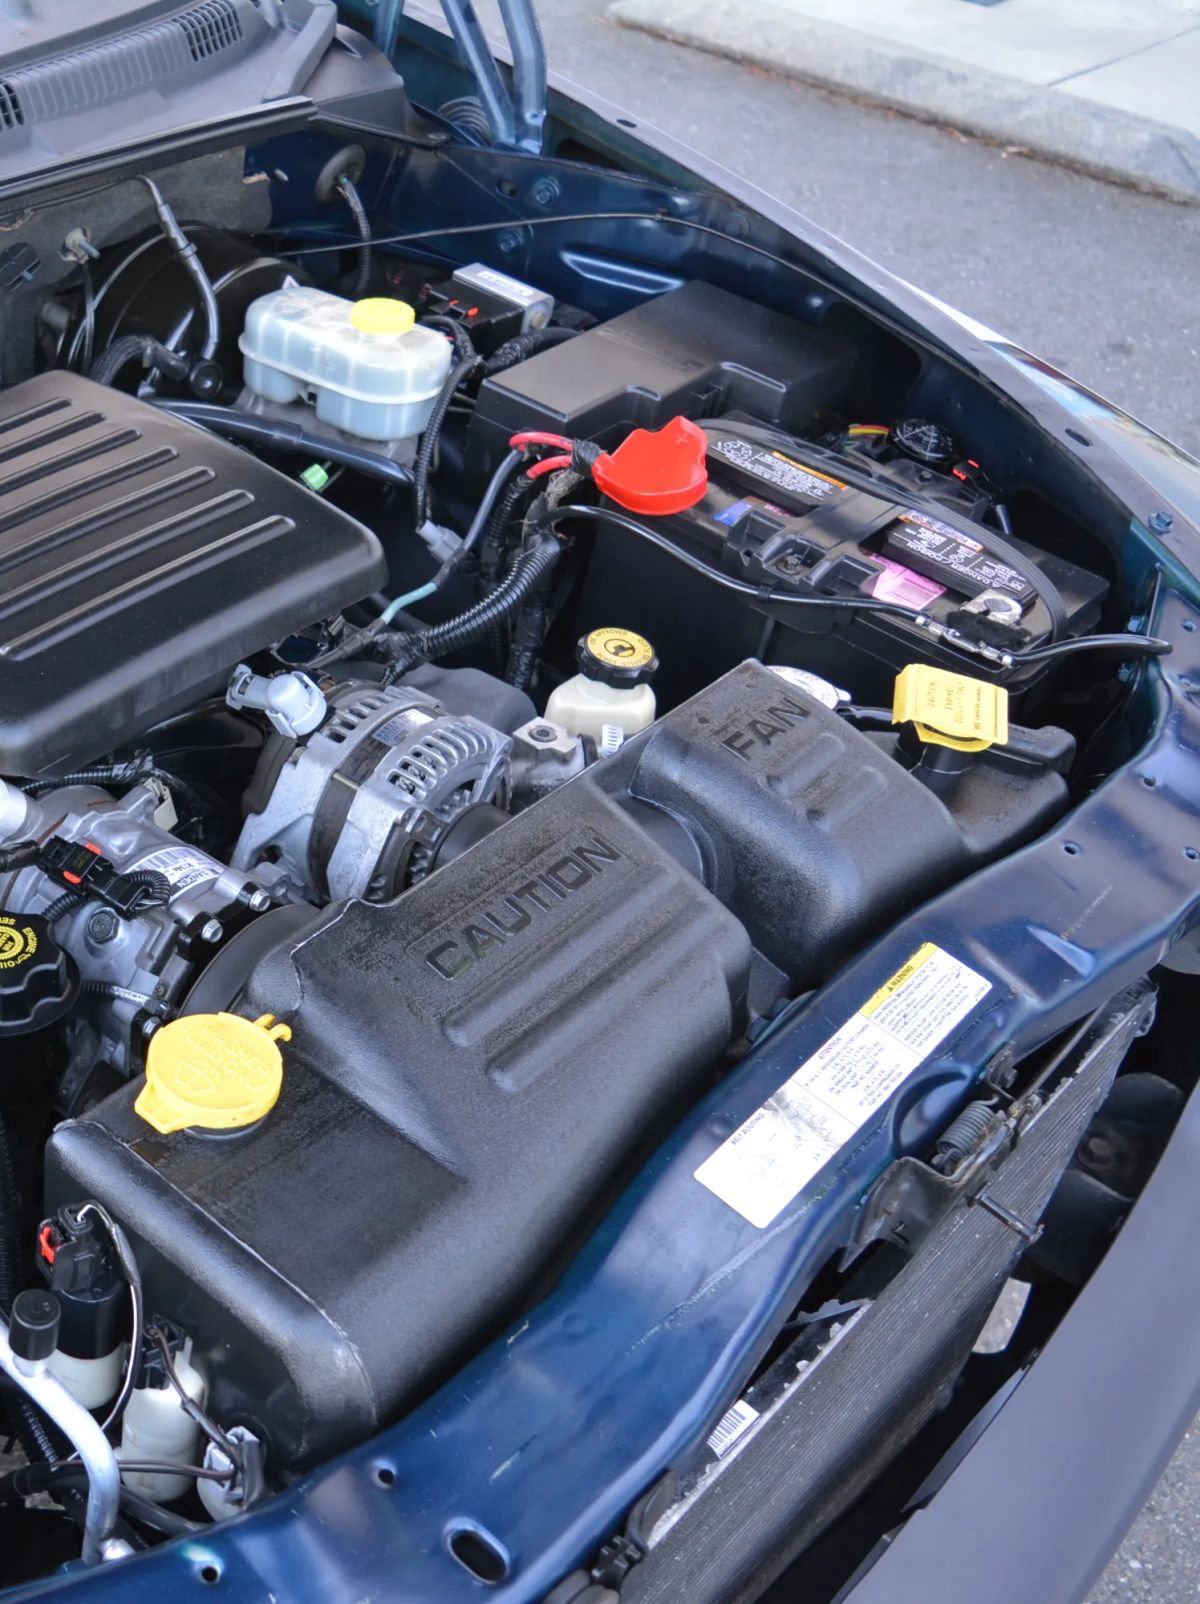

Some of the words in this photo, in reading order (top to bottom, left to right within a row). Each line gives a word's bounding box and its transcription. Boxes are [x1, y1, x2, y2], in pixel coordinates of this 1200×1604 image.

[425, 835, 622, 980] CAUTION
[721, 696, 811, 762] FAN
[22, 926, 38, 954] ENGINE
[893, 965, 914, 988] WARNING
